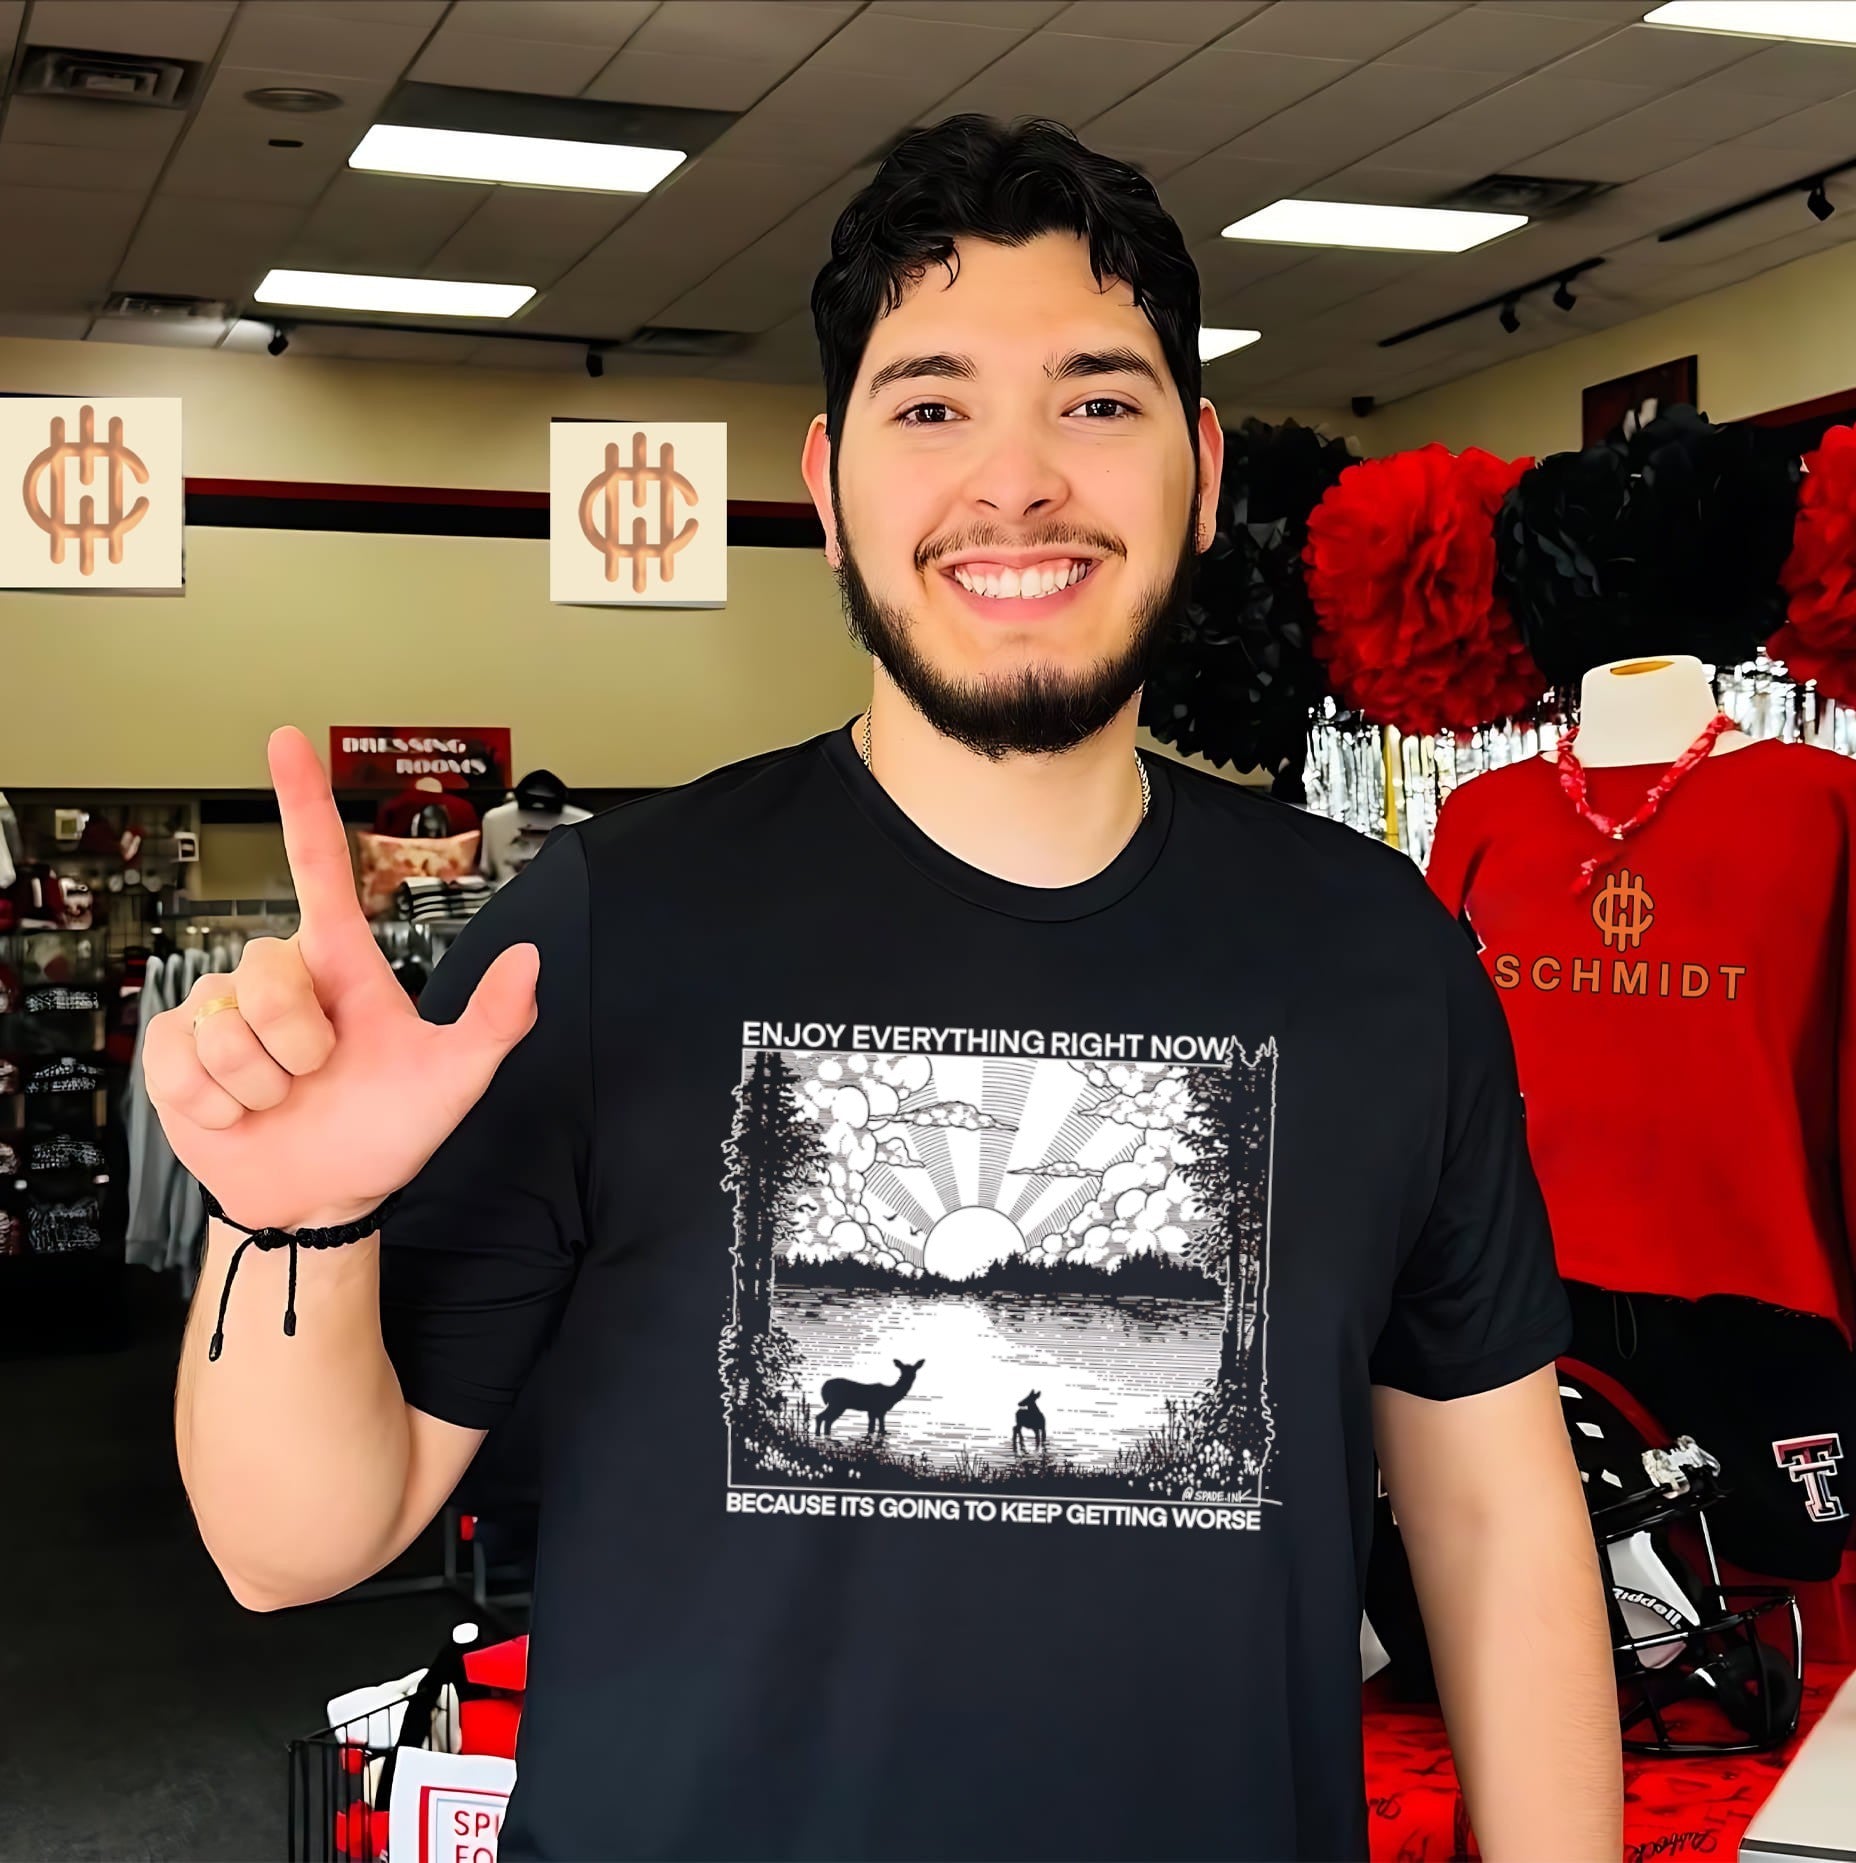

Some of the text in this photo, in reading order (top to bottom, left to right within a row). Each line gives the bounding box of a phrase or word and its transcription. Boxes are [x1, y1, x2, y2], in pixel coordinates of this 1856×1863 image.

[396, 758, 487, 775] ROOMS
[1494, 953, 1747, 1000] SCHMIDT
[742, 1021, 1230, 1061] ENJOY EVERYTHING RIGHT NOW
[726, 1492, 1261, 1531] BECAUSE ITS GOING TO KEEP GETTING WORSE
